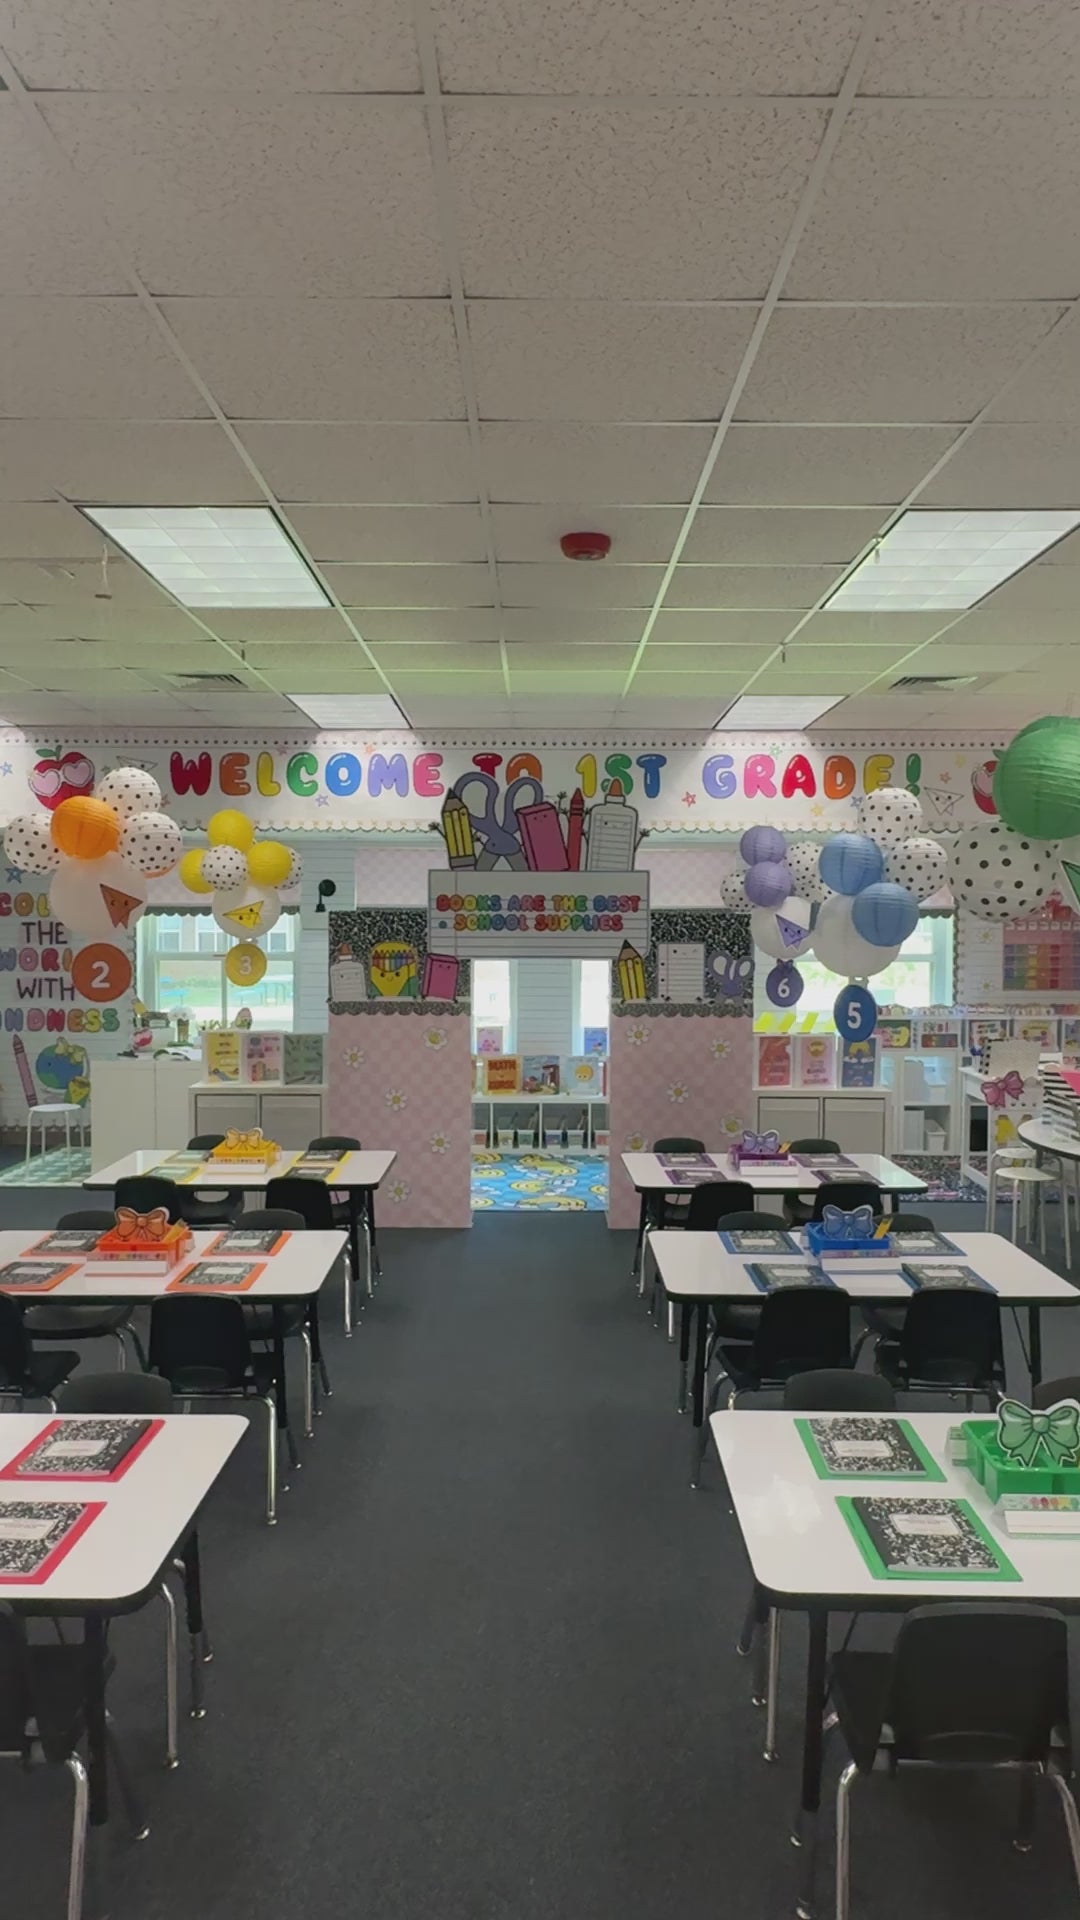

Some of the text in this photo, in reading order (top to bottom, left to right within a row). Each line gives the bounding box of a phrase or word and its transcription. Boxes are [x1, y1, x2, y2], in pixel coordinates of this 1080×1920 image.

[170, 751, 921, 799] WELCOME TO 1ST GRADE!
[0, 892, 50, 918] COL
[436, 894, 641, 912] BOOKS ARE THE BEST
[22, 920, 68, 945] THE
[454, 914, 623, 932] SCHOOL SUPPLIES
[91, 961, 110, 988] 2
[240, 956, 252, 975] 3
[17, 976, 75, 1001] WITH
[778, 978, 790, 998] 6
[0, 1007, 120, 1033] NDNESS
[847, 1002, 861, 1029] 5
